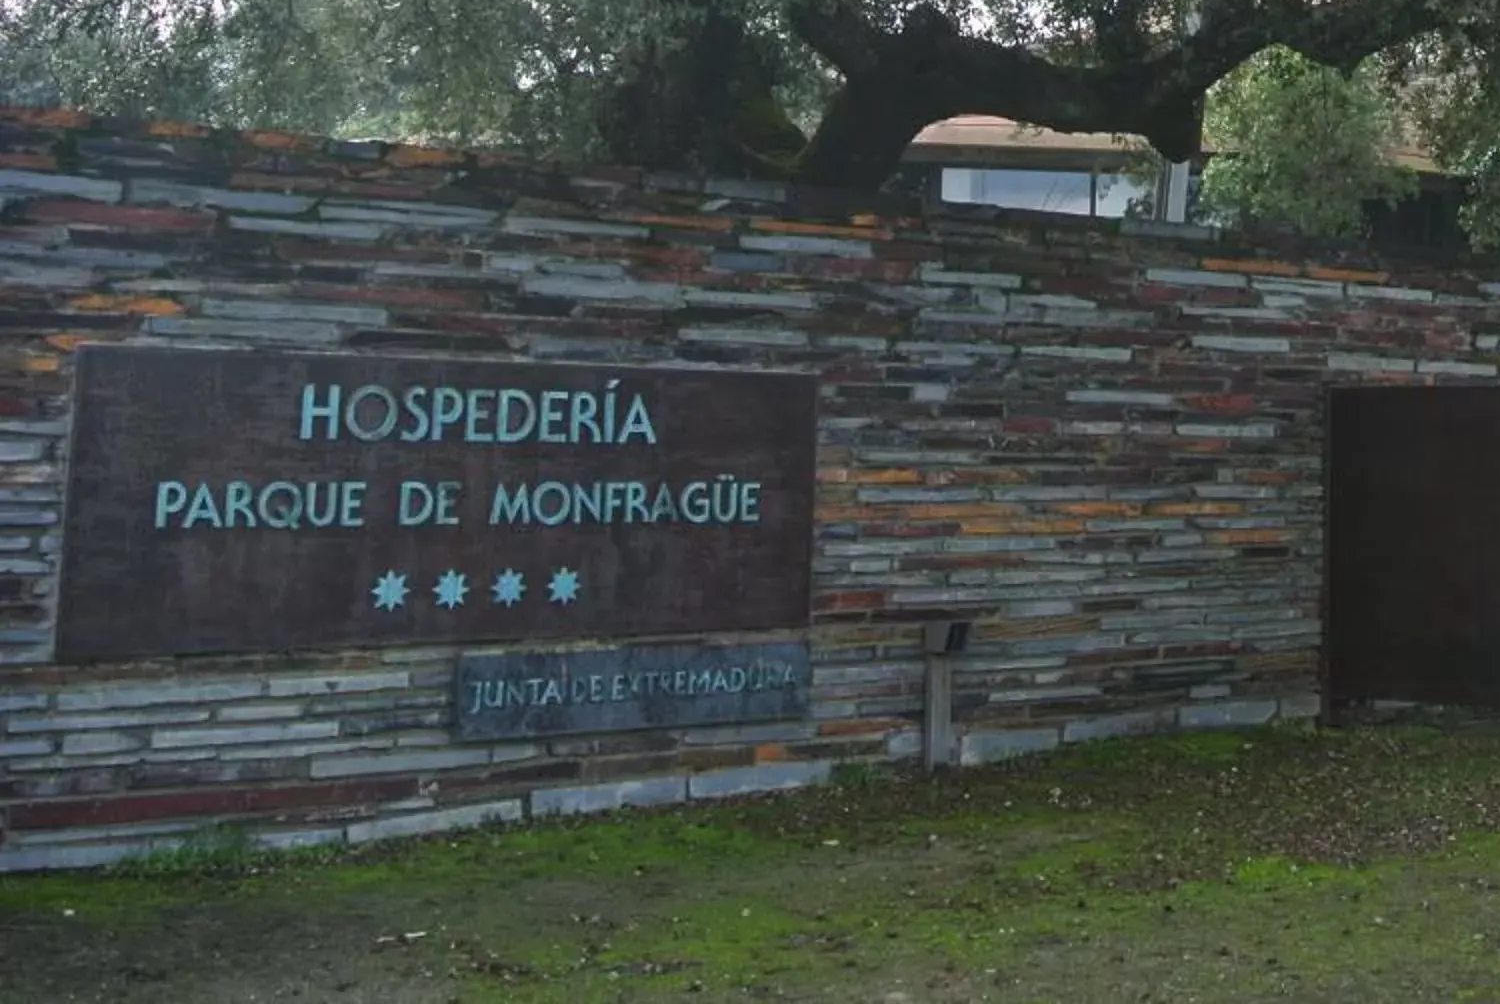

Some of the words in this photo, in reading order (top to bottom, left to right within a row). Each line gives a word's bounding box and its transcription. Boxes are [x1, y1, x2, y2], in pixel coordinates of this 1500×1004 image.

[300, 380, 657, 444] HOSPEDERÍA
[155, 480, 365, 529] PARQUE
[399, 481, 460, 526] DE
[489, 473, 761, 526] MONFRAGÜE
[469, 678, 562, 714] JUNTA
[571, 675, 602, 703] DE
